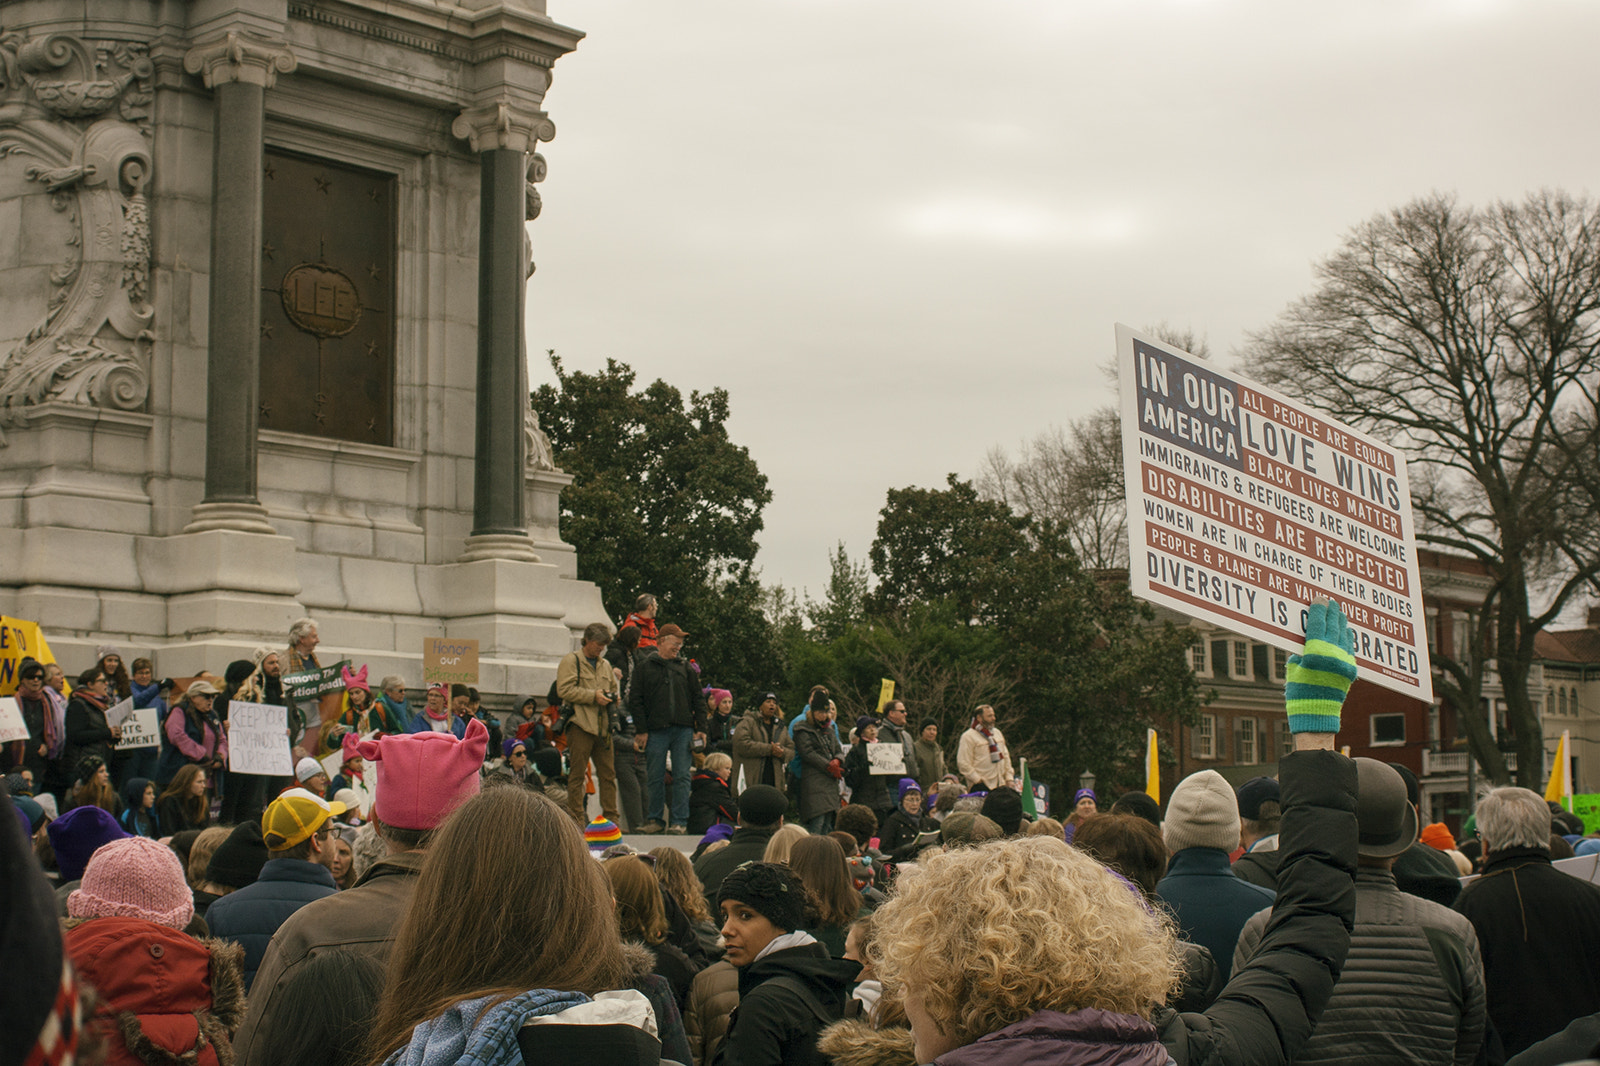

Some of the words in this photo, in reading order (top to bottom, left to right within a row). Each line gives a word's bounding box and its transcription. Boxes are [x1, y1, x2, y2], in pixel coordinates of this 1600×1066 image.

[294, 278, 353, 322] LEE
[1138, 351, 1169, 398] IN
[1182, 371, 1237, 427] OUR
[1143, 397, 1239, 461] AMERICA
[1242, 389, 1267, 415] ALL
[1272, 402, 1321, 438] PEOPLE
[1325, 427, 1350, 452] ARE
[1353, 440, 1392, 472] EQUAL
[1245, 412, 1317, 475] LOVE
[1331, 450, 1401, 512] WINS
[1139, 436, 1229, 489] IMMIGRANTS
[1233, 475, 1244, 496] &
[1248, 481, 1315, 525] REFUGEES
[1319, 510, 1344, 537] ARE
[1346, 521, 1406, 564] WELCOME
[1147, 468, 1266, 535] DISABILITIES
[1274, 519, 1307, 552] ARE
[1314, 535, 1405, 592] RESPECTED
[1247, 454, 1294, 490] BLACK
[1300, 476, 1340, 508] LIVES
[1345, 496, 1399, 535] MATTER
[1143, 497, 1195, 533] WOMEN
[1201, 520, 1228, 546] ARE
[1233, 532, 1248, 554] IN
[1254, 541, 1304, 576] CHARGE
[1309, 563, 1324, 583] OF
[1330, 571, 1367, 601] THEIR
[1371, 588, 1414, 619] BODIES
[1151, 527, 1198, 560] PEOPLE
[1202, 547, 1213, 566] &
[1217, 552, 1262, 584] PLANET
[1268, 572, 1291, 595] ARE
[1340, 601, 1369, 625] OVER
[1373, 612, 1410, 640] PROFIT
[13, 627, 26, 651] TO
[432, 640, 473, 656] Honor
[1146, 550, 1257, 615] DIVERSITY
[1269, 596, 1289, 627] IS
[1300, 609, 1420, 675] CBRATED
[440, 656, 461, 666] our
[231, 704, 260, 728] KEEP
[262, 706, 286, 729] YOUR
